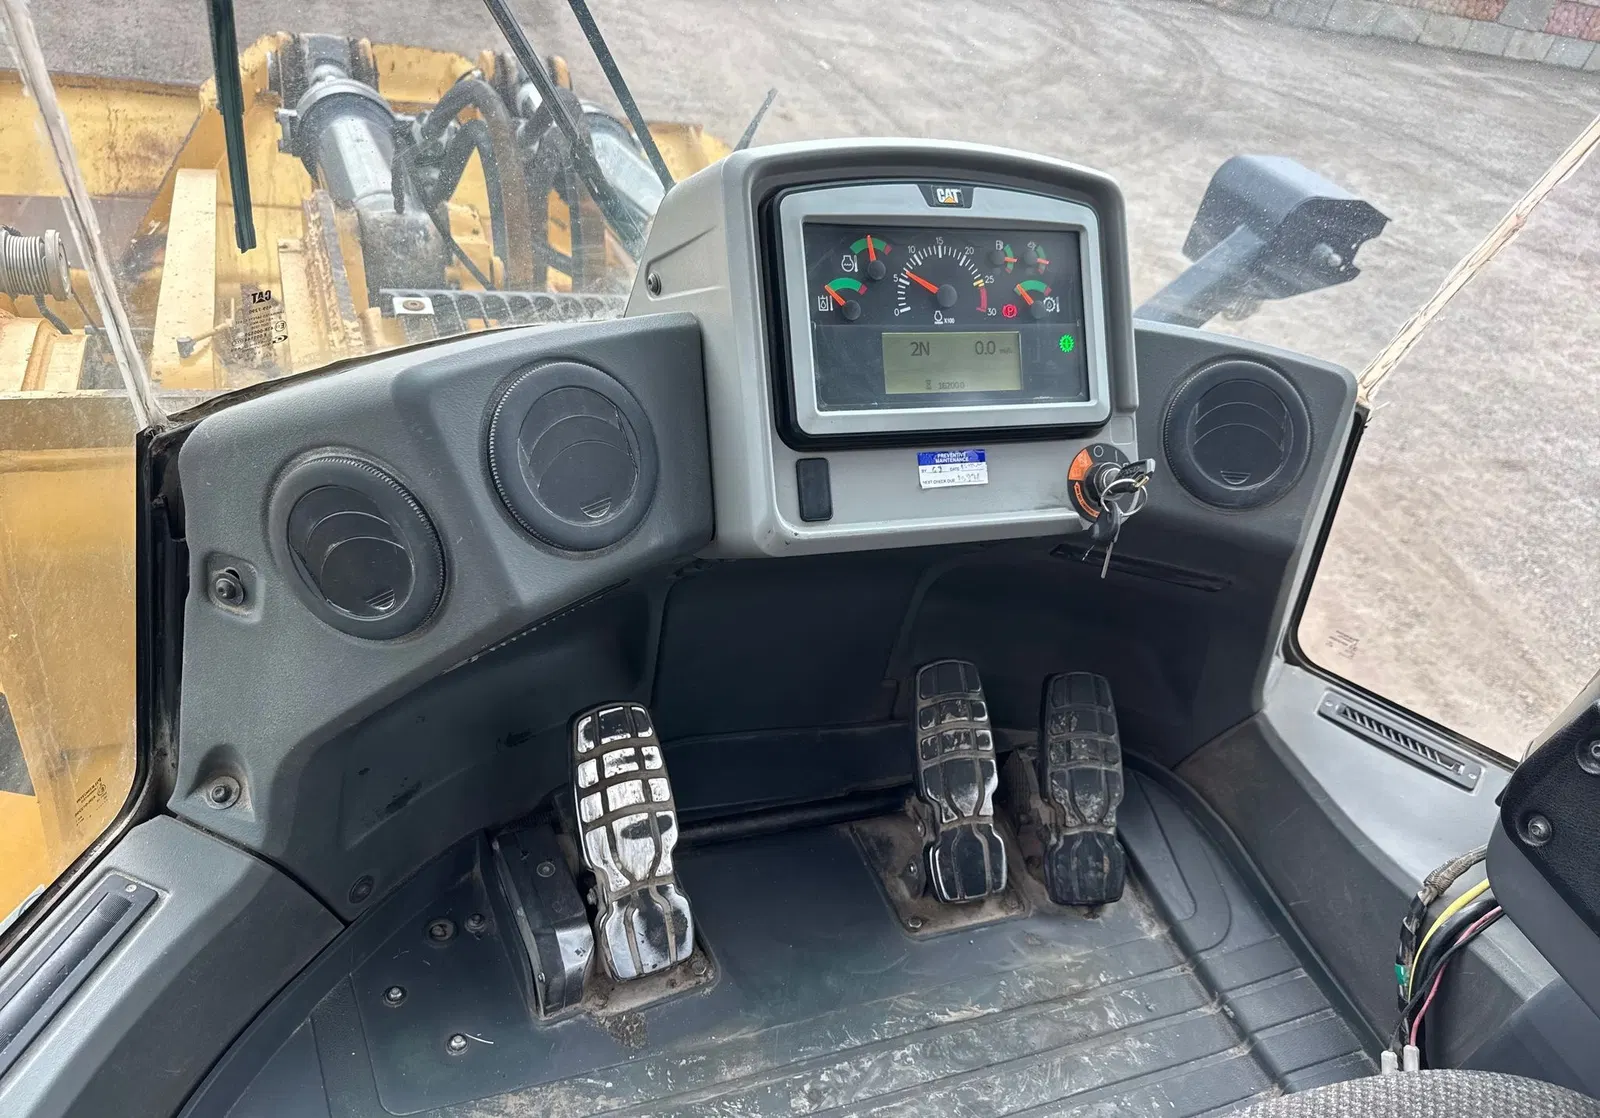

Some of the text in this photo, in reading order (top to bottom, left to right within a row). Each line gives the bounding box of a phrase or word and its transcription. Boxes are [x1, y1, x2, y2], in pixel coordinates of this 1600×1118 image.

[936, 188, 962, 204] CAT
[935, 237, 944, 246] 15
[907, 245, 916, 254] 10
[964, 246, 975, 255] 20
[893, 275, 899, 283] 5
[984, 275, 995, 284] 25
[893, 308, 900, 317] 0
[987, 307, 997, 317] 30
[910, 341, 930, 357] 2N
[974, 340, 996, 355] 0.0
